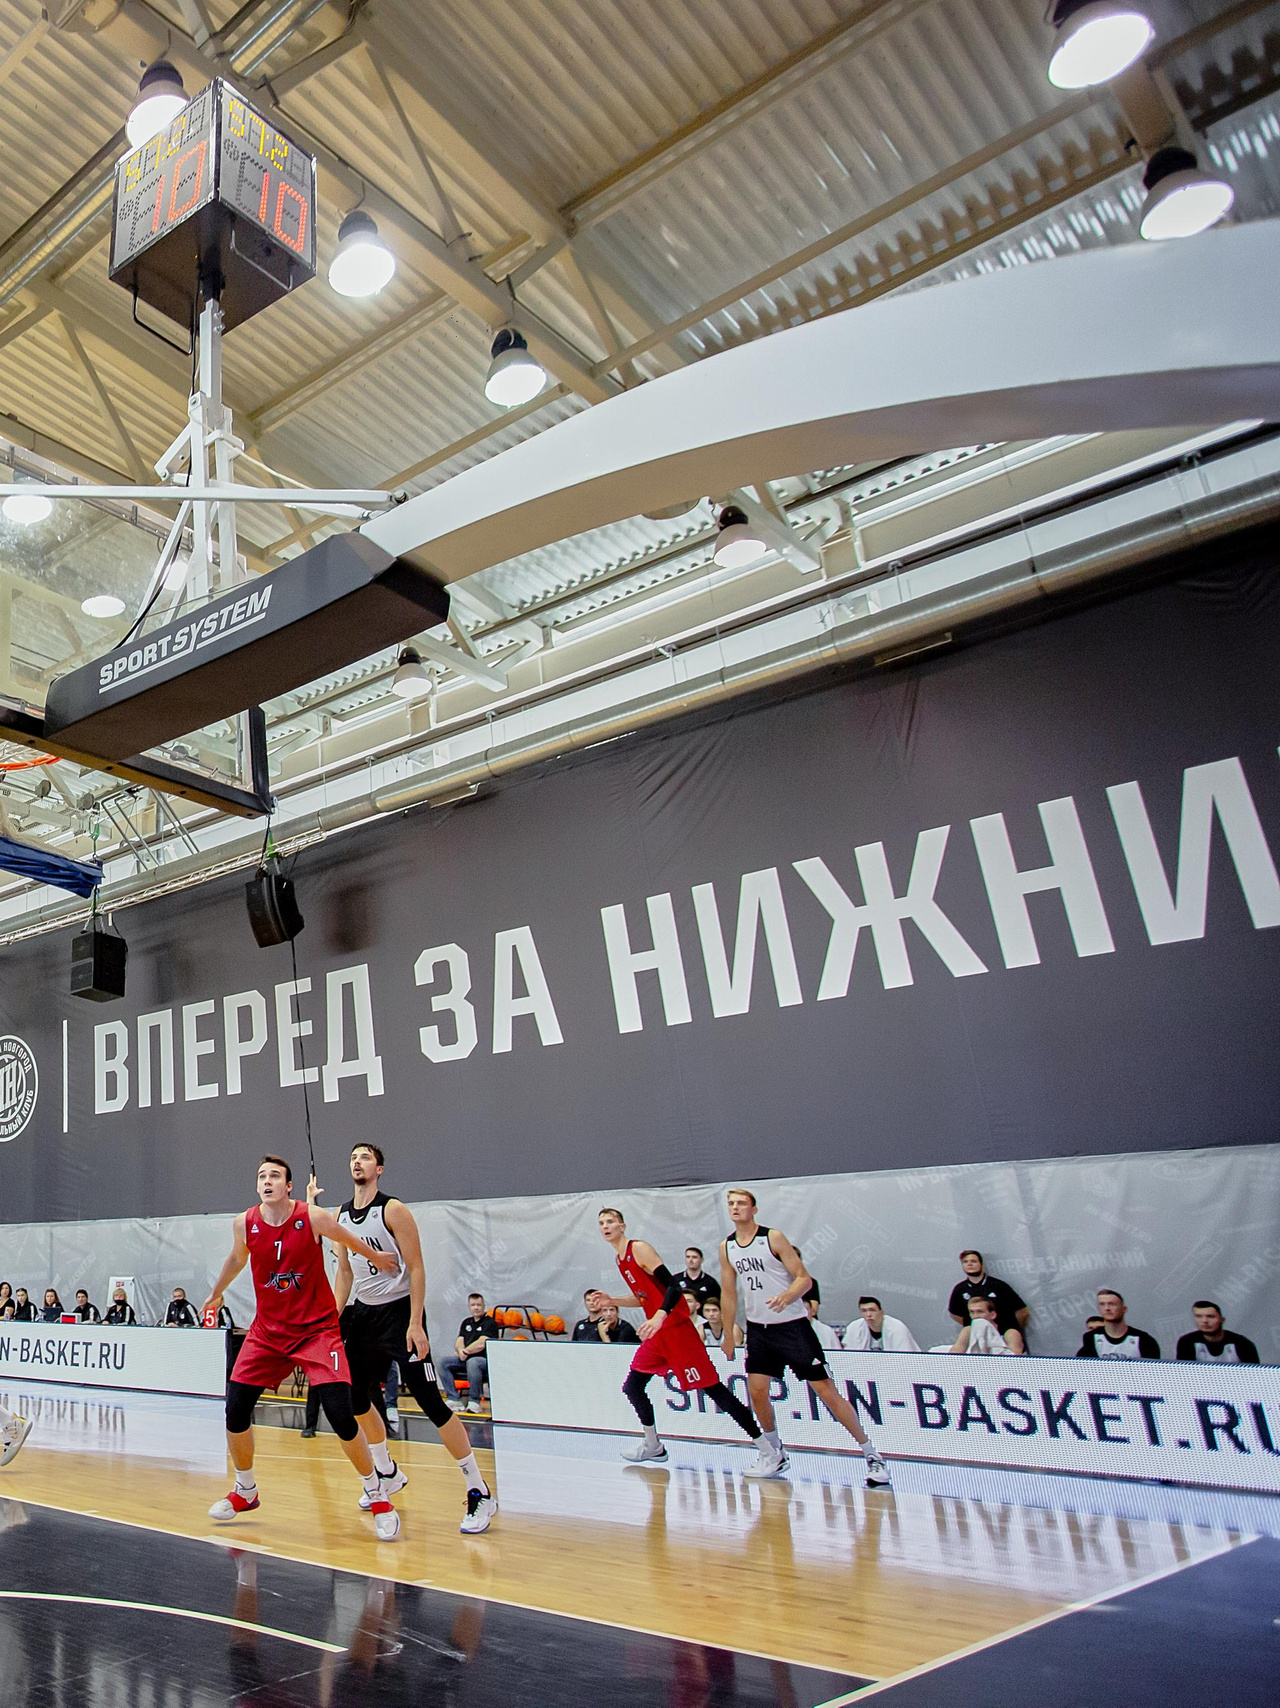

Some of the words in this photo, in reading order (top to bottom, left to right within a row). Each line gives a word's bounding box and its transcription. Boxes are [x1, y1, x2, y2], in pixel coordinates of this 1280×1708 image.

[151, 139, 207, 233] 10
[260, 172, 309, 254] 10
[94, 963, 384, 1114] ВПЕРЕД
[413, 925, 564, 1064] ЗА
[600, 747, 1280, 1034] НИЖНИ
[3, 1041, 33, 1074] НОВГОРОД
[274, 1240, 282, 1261] 7
[735, 1257, 765, 1275] BCNN
[746, 1276, 764, 1291] 24
[204, 1308, 216, 1327] 5
[330, 1351, 340, 1371] 7
[684, 1367, 701, 1384] 20
